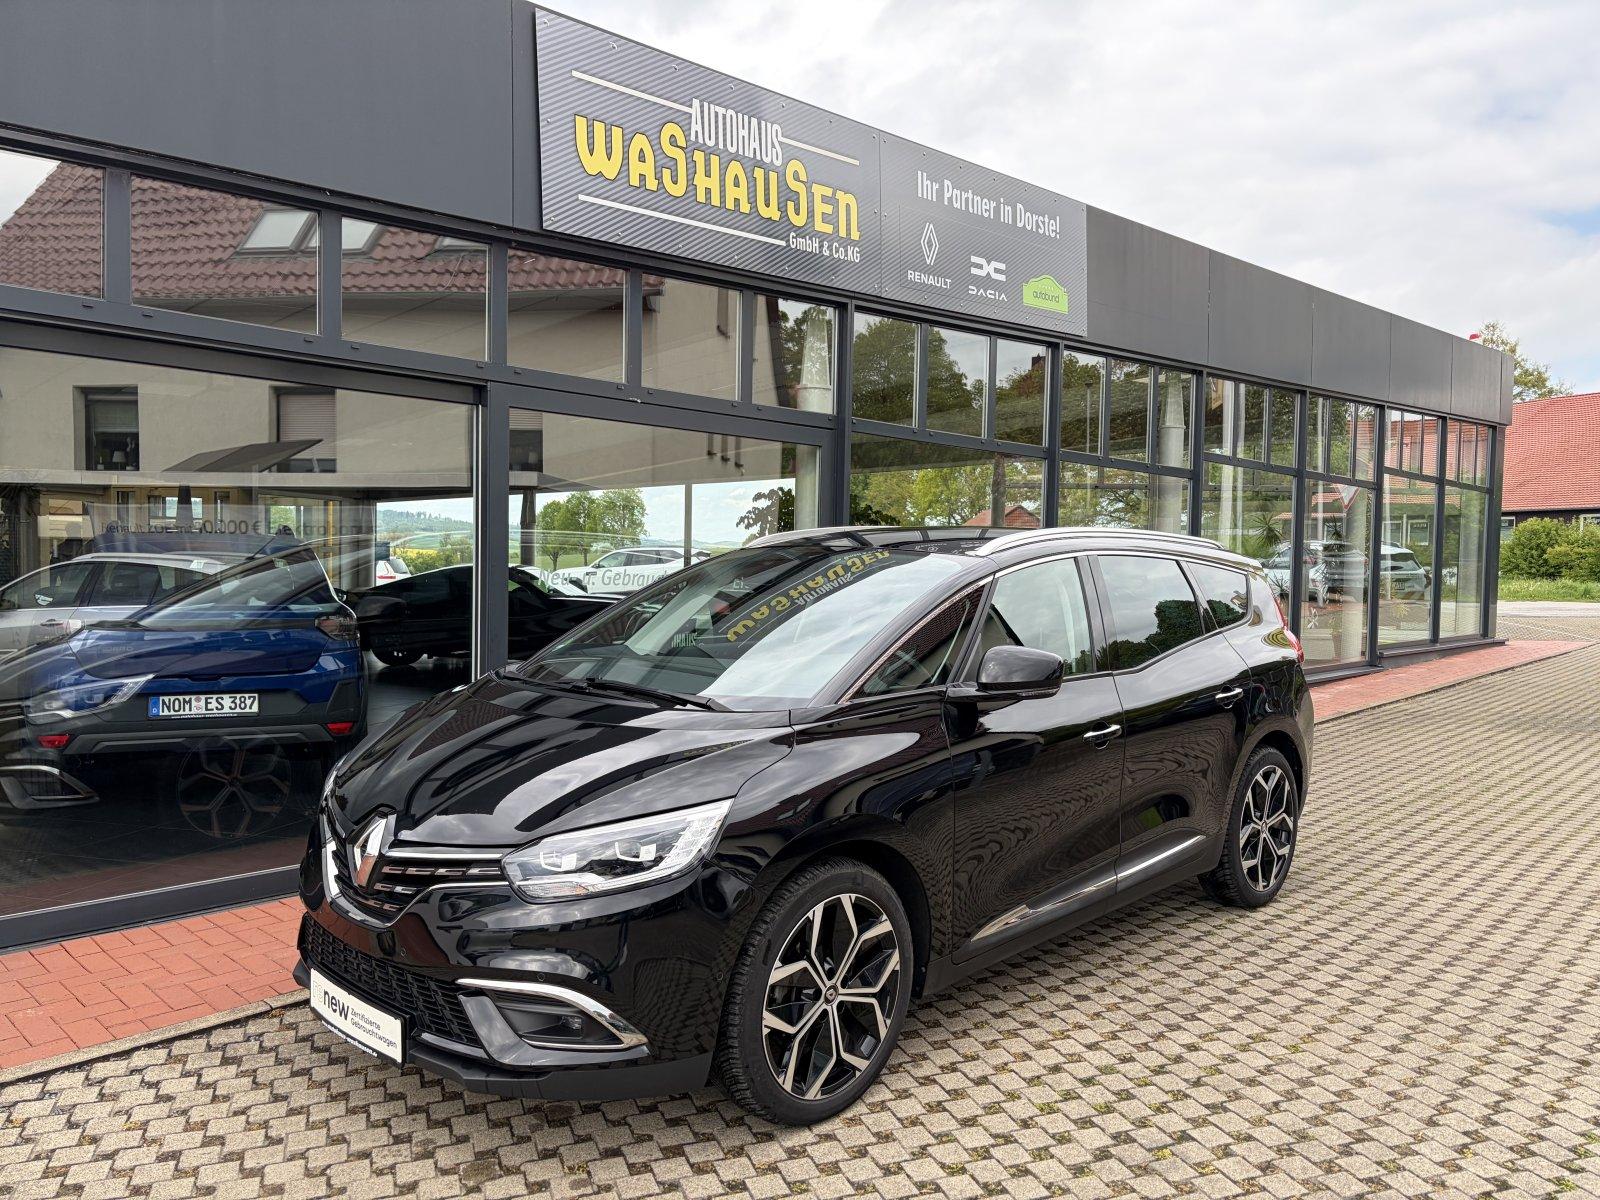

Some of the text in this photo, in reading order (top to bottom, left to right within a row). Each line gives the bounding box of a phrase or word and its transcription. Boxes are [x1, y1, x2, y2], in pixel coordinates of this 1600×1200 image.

[690, 98, 783, 167] AUTOHAUS
[917, 170, 1060, 239] Ihr Partner in Dorste!
[789, 231, 819, 254] GmbH
[822, 241, 830, 257] &
[907, 269, 952, 289] RENAULT
[968, 285, 1008, 302] DACIA
[1032, 290, 1060, 303] autobund
[161, 697, 193, 714] NOM
[204, 696, 225, 712] ES
[228, 695, 257, 711] 387
[350, 1017, 398, 1049] Gebrauchtwagen
